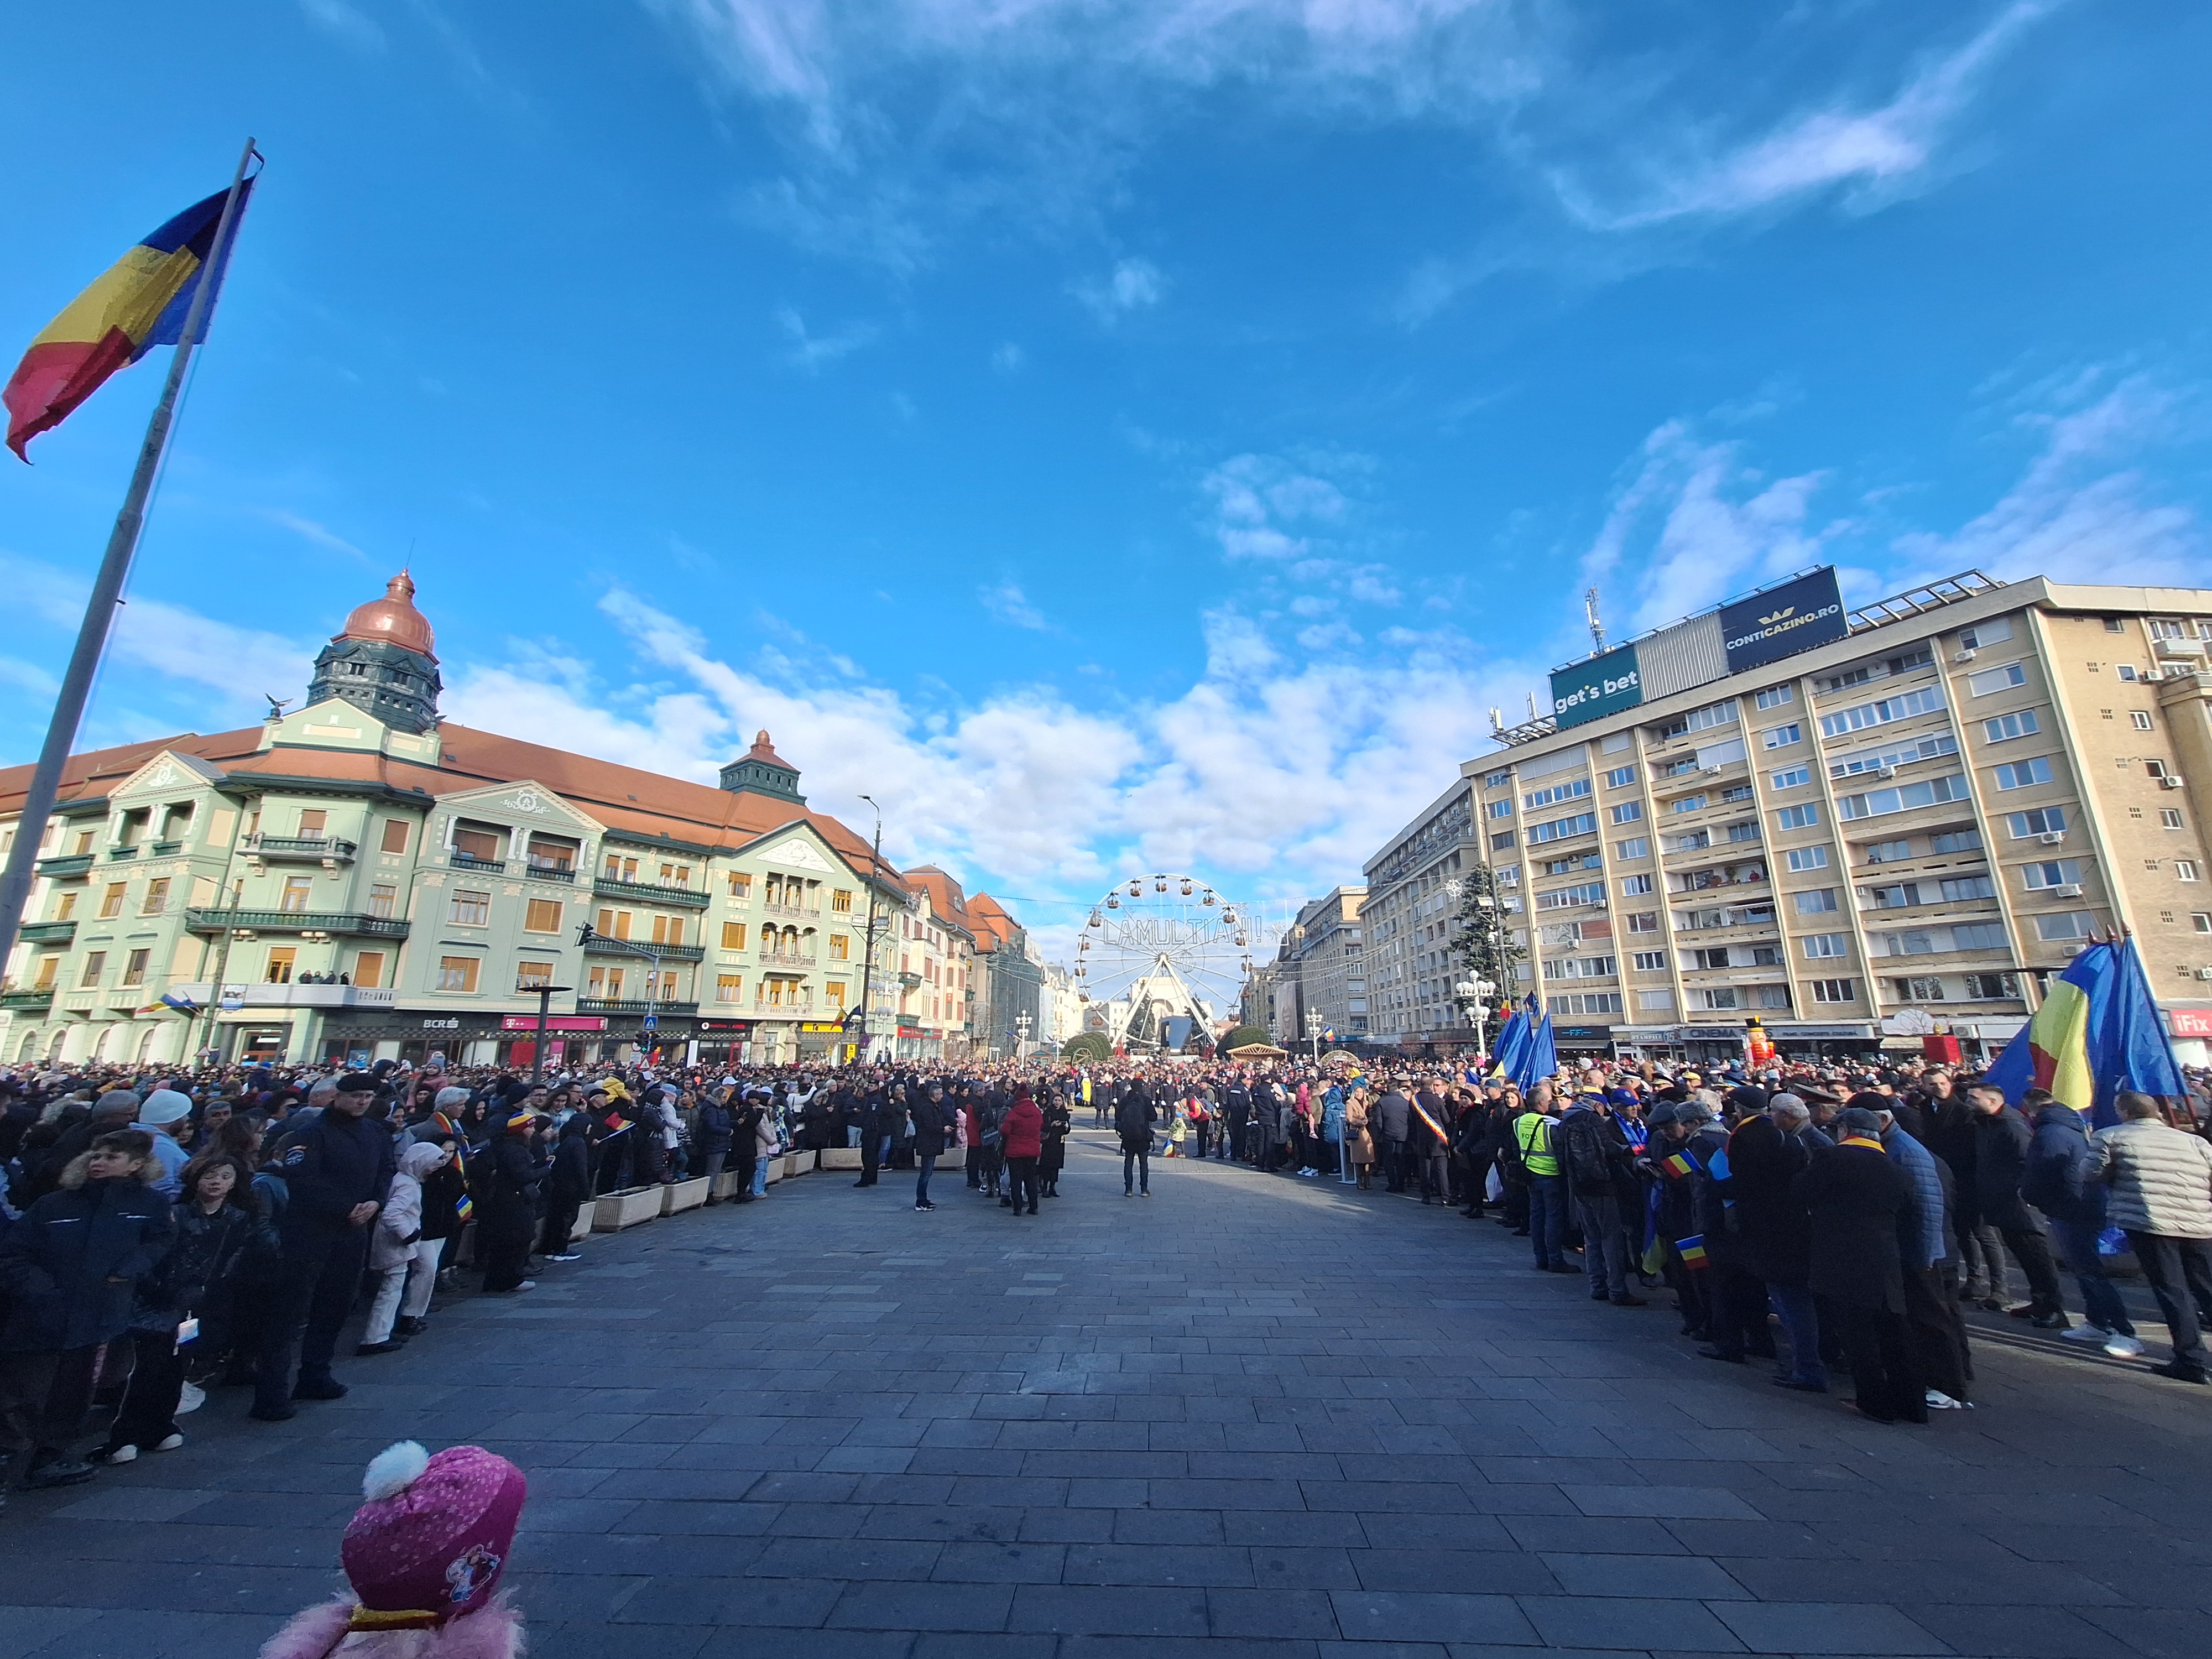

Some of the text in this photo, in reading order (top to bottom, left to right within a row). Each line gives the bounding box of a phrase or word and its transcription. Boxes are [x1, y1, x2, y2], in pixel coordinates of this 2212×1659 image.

[1726, 604, 1839, 650] CONTICAZINO.RO
[1555, 671, 1638, 714] get's bet
[1104, 919, 1134, 945] LA
[423, 1019, 446, 1028] BCR
[2176, 1014, 2210, 1032] iFix
[1666, 1032, 1674, 1043] 15
[1690, 1029, 1737, 1038] CINEMA
